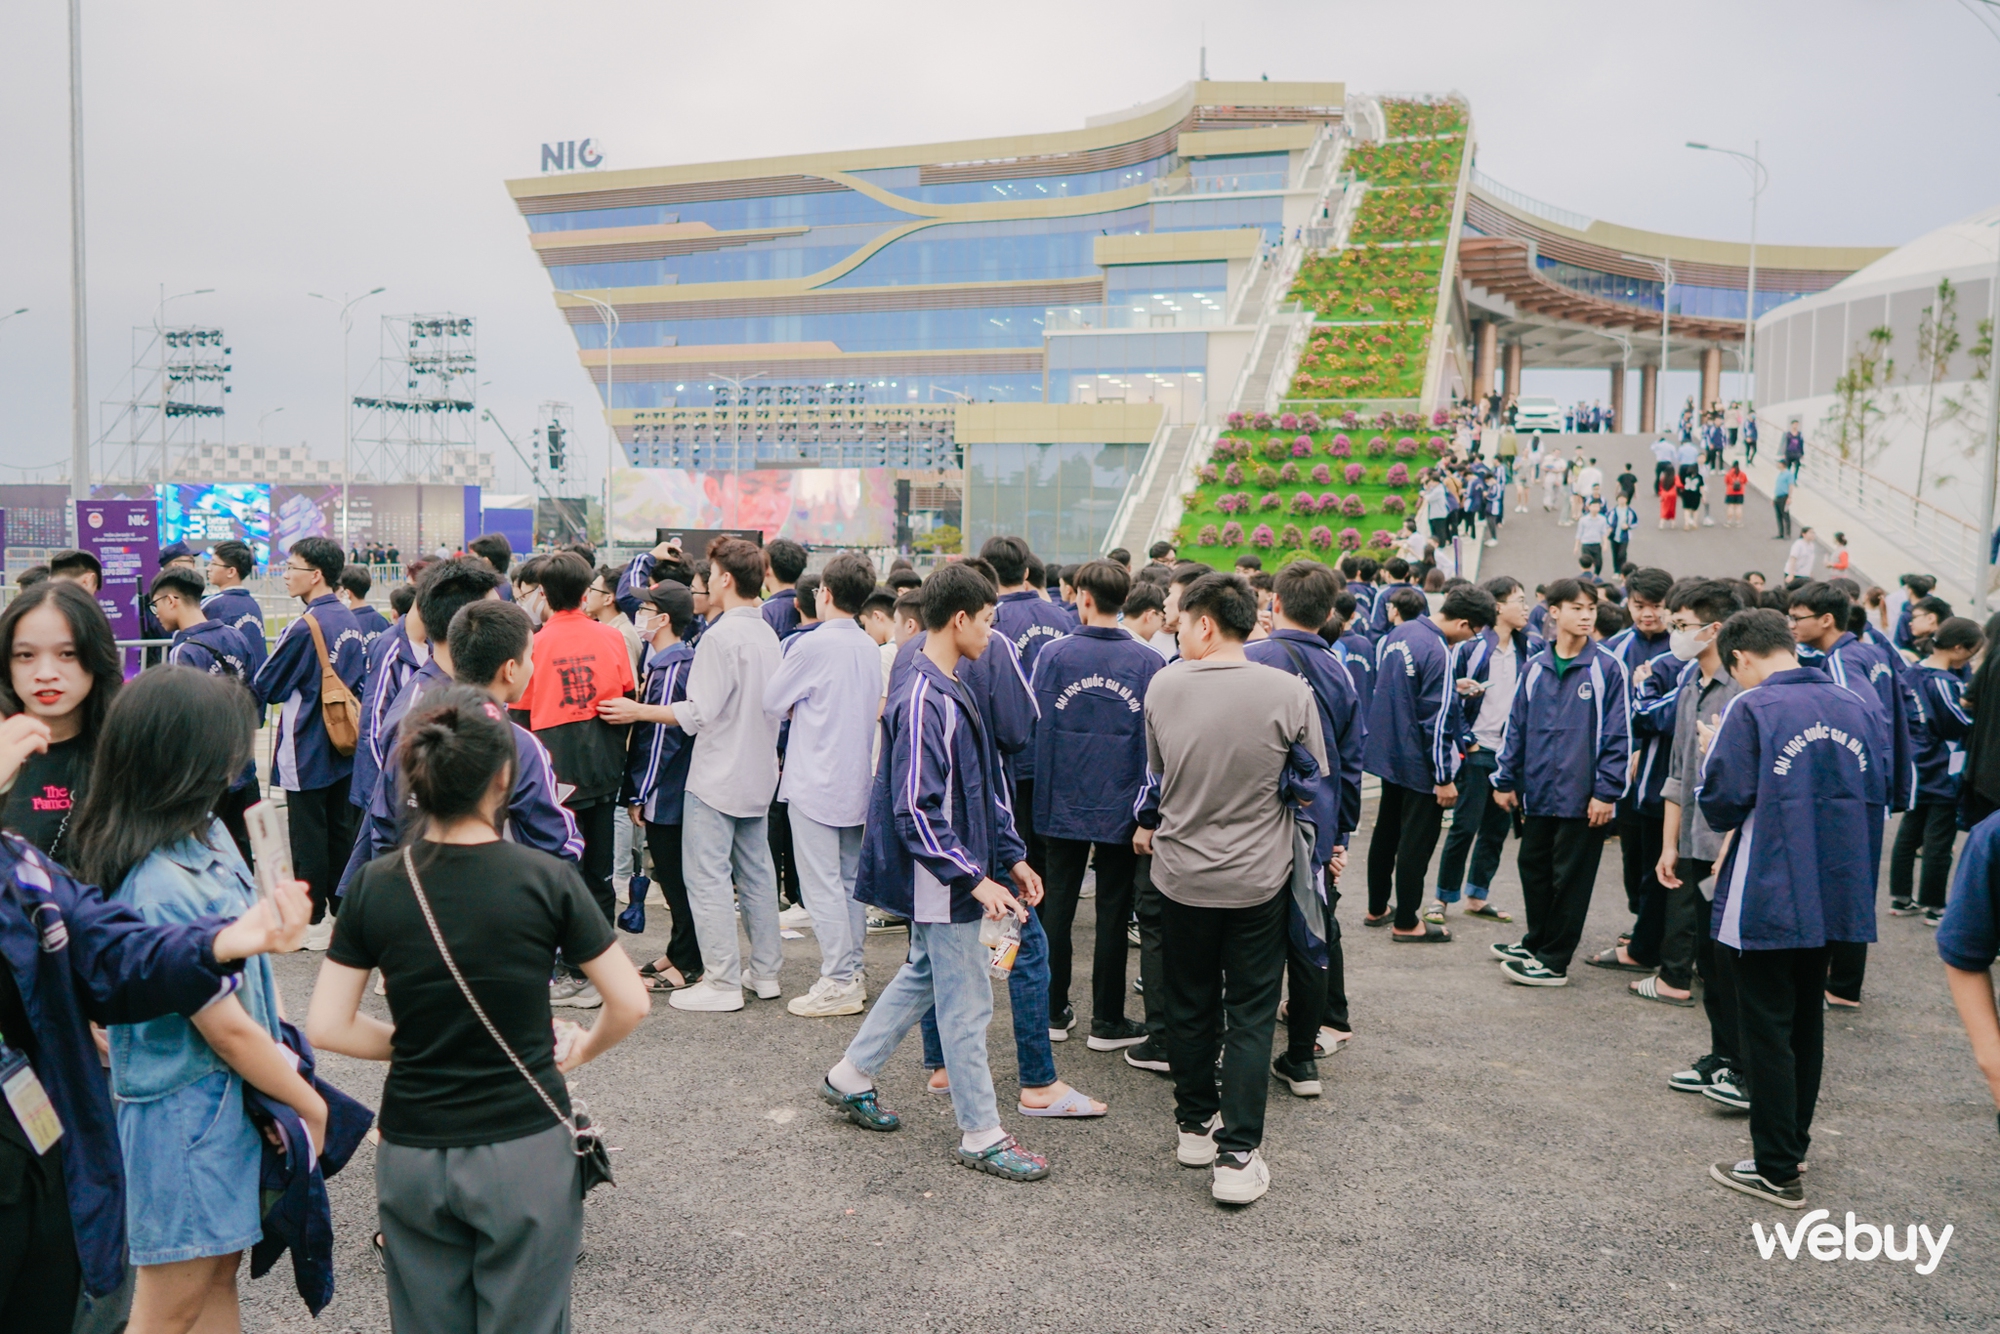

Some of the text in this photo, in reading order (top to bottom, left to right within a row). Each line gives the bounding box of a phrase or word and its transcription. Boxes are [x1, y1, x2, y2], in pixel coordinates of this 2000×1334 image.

[541, 138, 604, 172] NIC
[128, 514, 150, 526] NIC
[1055, 694, 1069, 711] ĐẠI
[1064, 682, 1082, 697] HỌC
[1081, 673, 1105, 689] QUỐC
[1105, 679, 1120, 693] GIA
[1803, 721, 1830, 742] QUỐC
[1830, 728, 1848, 746] GIA
[1782, 735, 1807, 757] HỌC
[1773, 755, 1792, 776] ĐẠI
[42, 785, 69, 799] The
